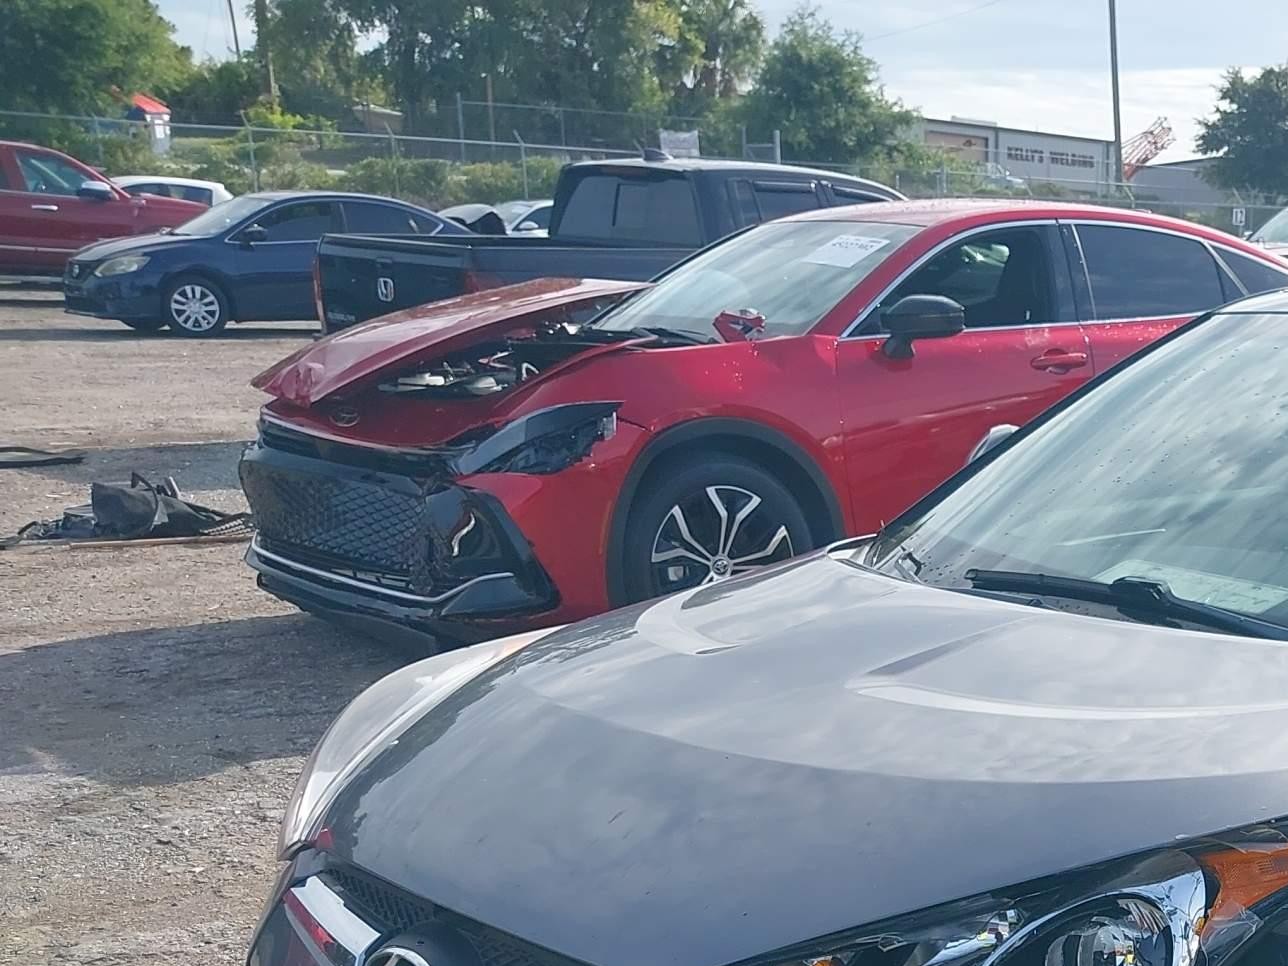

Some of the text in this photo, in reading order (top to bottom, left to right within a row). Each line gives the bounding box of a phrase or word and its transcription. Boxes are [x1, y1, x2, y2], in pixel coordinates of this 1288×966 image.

[1007, 146, 1095, 169] KELLY'S WELDING
[1234, 210, 1244, 224] 12
